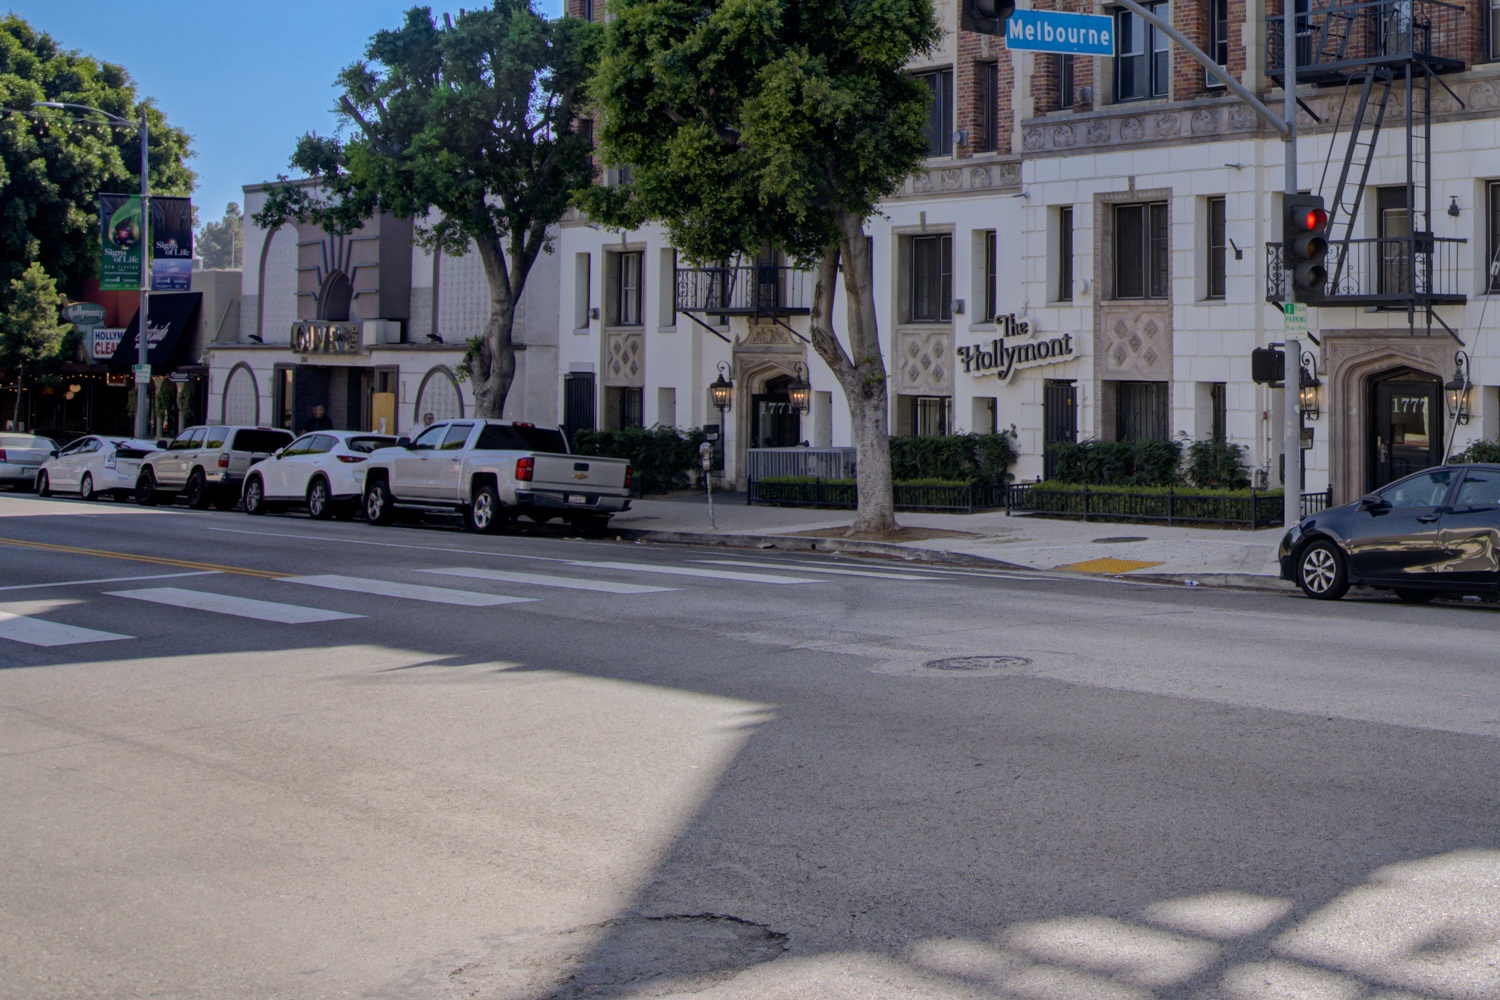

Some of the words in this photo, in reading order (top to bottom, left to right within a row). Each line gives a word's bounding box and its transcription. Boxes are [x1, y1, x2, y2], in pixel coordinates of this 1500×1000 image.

[1009, 19, 1110, 46] Melbourne
[104, 248, 127, 258] Signs
[156, 240, 178, 250] Signs
[996, 313, 1029, 337] The
[957, 333, 1073, 380] Hollymont
[760, 402, 793, 414] 1771
